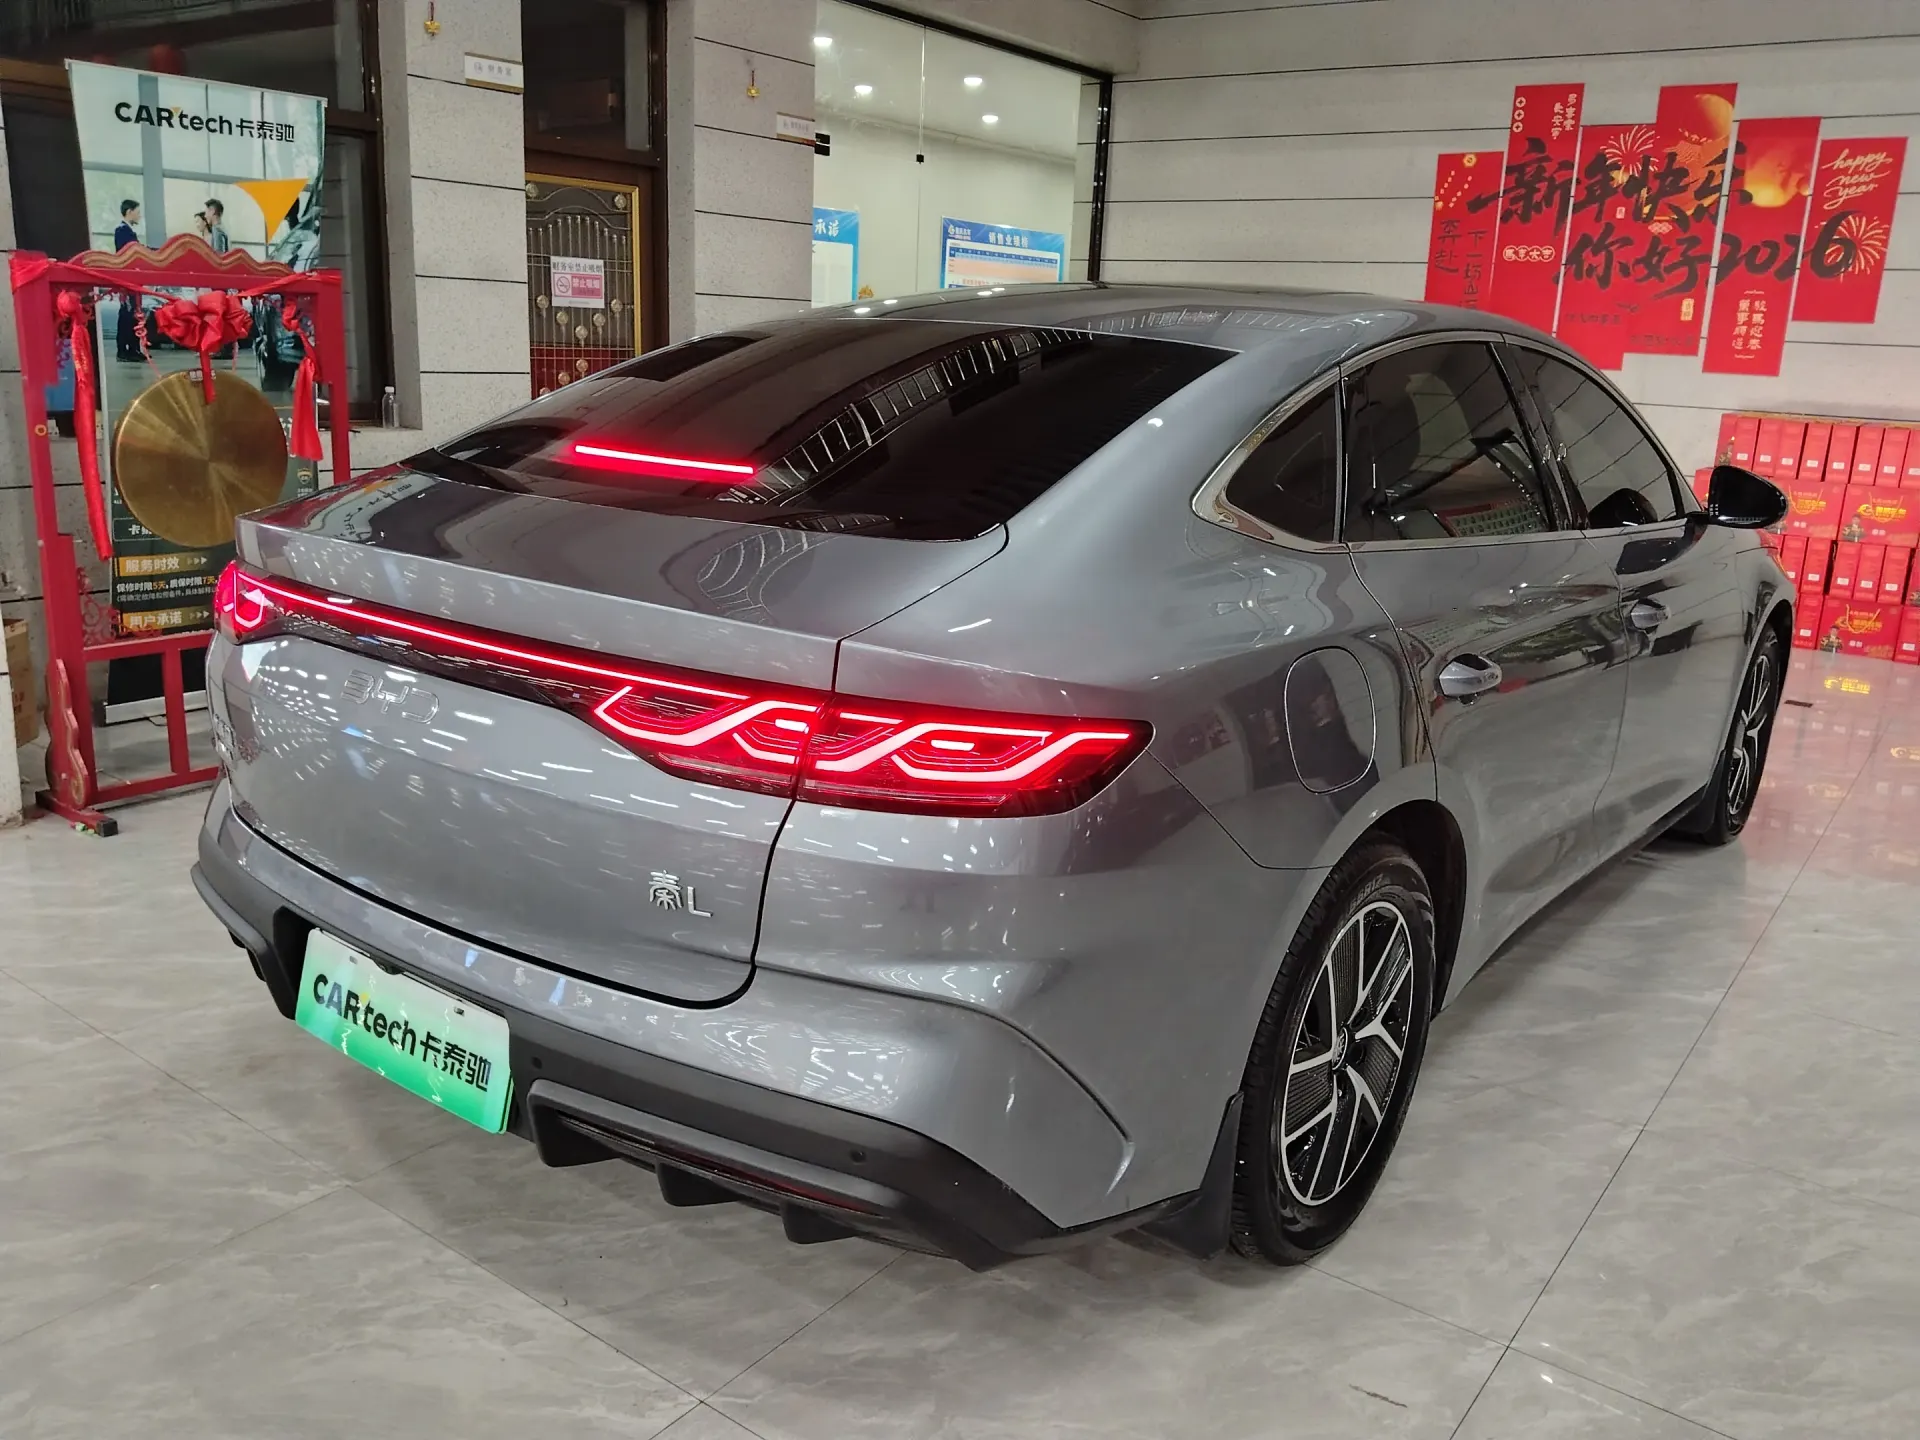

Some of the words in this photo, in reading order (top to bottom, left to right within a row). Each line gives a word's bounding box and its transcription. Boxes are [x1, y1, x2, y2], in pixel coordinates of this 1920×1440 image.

[115, 101, 233, 136] CARtech
[236, 119, 295, 143] 卡泰驰
[1822, 149, 1892, 173] happy
[1826, 170, 1890, 186] new
[1823, 183, 1878, 210] year
[126, 557, 180, 573] 服务时效
[130, 611, 182, 628] 用户承诺
[341, 669, 440, 724] BYD
[313, 973, 417, 1056] CARtech
[419, 1031, 492, 1092] 卡泰驰
